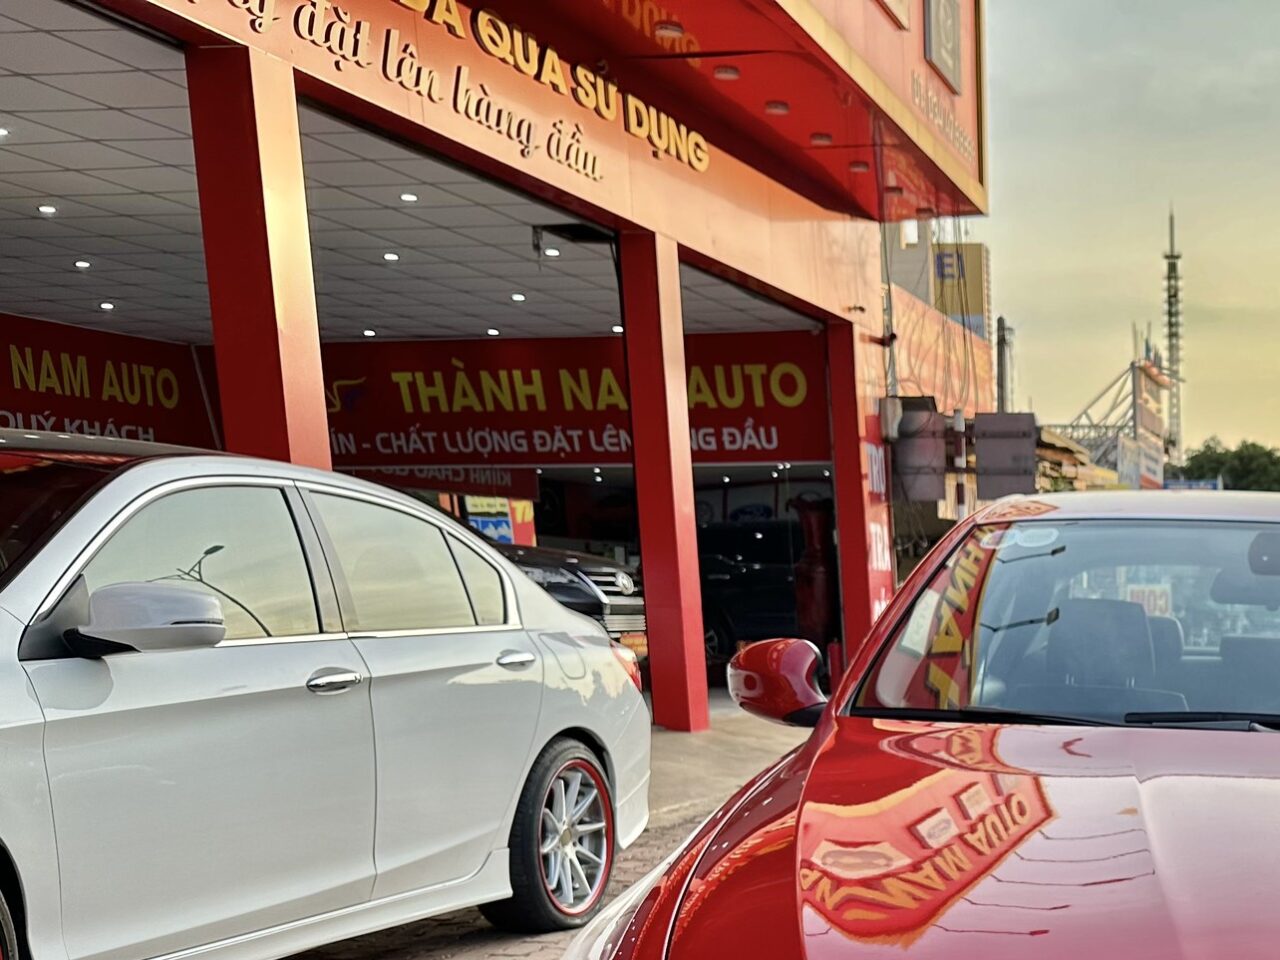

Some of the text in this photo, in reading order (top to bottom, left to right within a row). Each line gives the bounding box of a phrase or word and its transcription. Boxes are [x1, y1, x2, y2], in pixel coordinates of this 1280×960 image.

[294, 1, 374, 71] đặt
[381, 28, 444, 103] lên
[452, 65, 540, 159] hàng
[546, 119, 603, 182] đầu
[473, 8, 568, 95] QUA
[626, 92, 710, 172] DỤNG
[10, 344, 180, 409] NAM AUTO
[391, 357, 807, 413] THÀNH NA AUTO
[331, 427, 357, 455] ÍN
[375, 423, 437, 454] CHẤT
[444, 425, 528, 459] LƯỢNG
[533, 425, 582, 458] ĐẶT
[722, 417, 778, 450] ĐẦU
